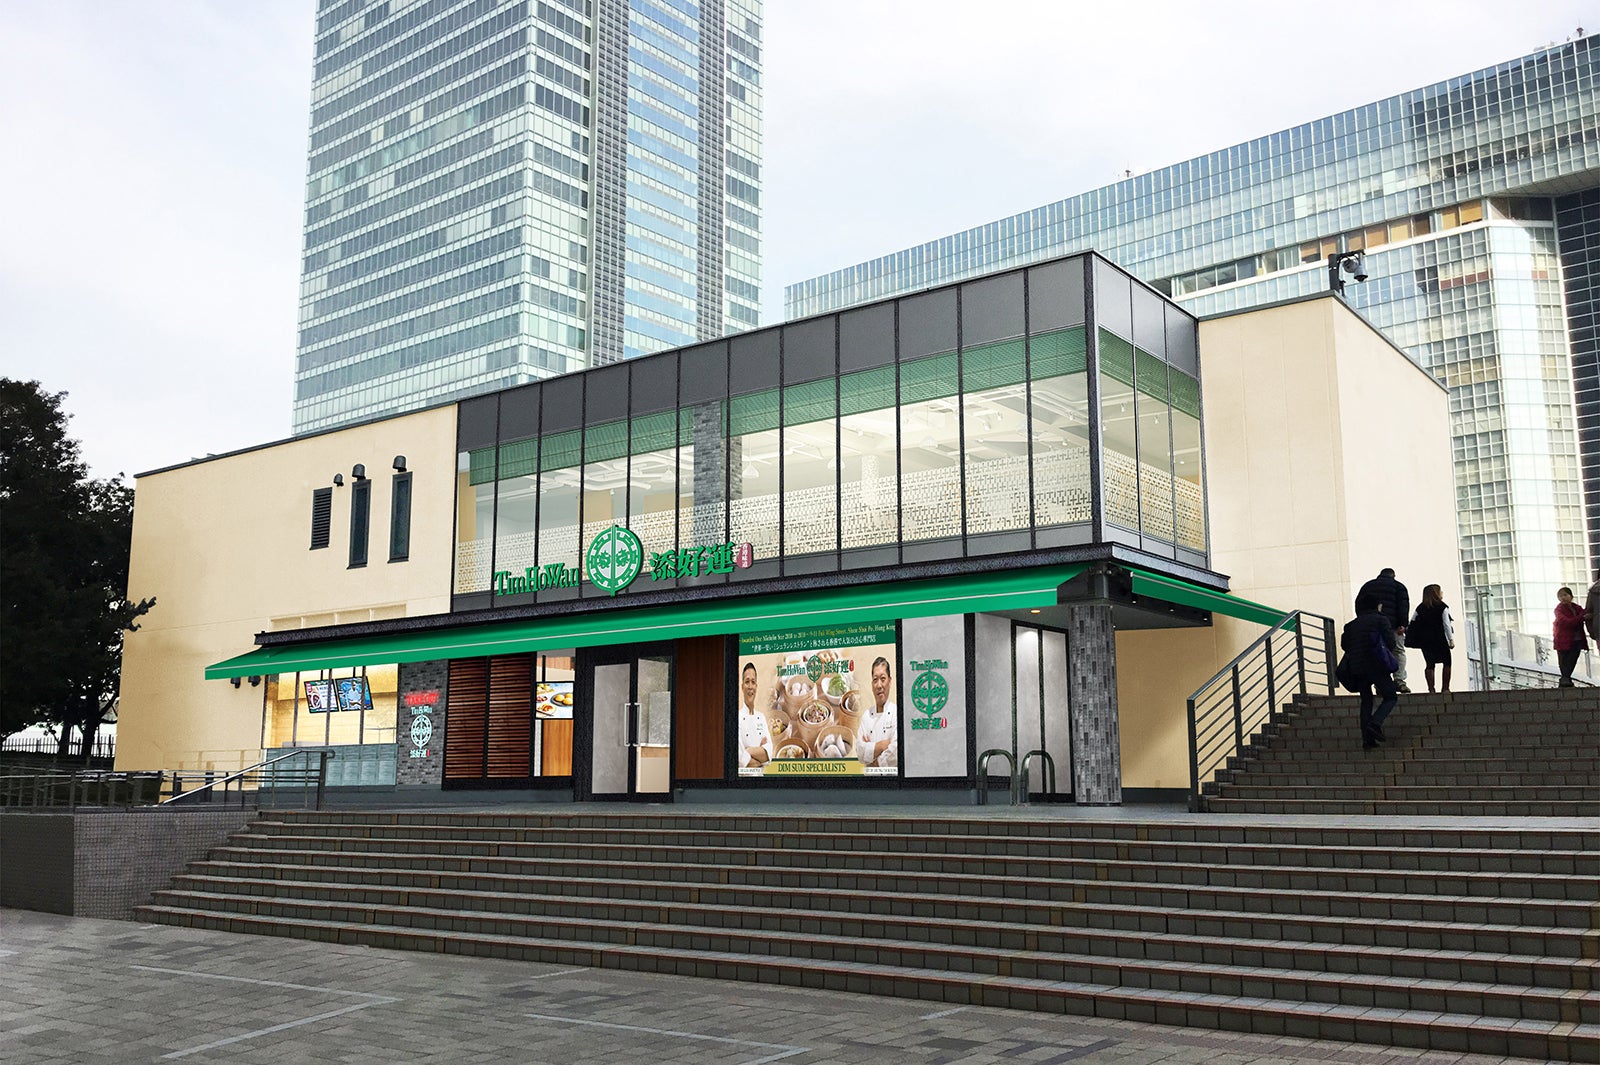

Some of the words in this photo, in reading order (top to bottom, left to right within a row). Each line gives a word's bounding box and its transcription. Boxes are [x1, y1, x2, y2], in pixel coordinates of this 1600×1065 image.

[648, 541, 735, 581] 添好運
[494, 563, 580, 596] TimHoWan
[778, 763, 790, 772] DIM
[791, 763, 805, 772] SUM
[806, 763, 846, 772] SPECIALISTS
